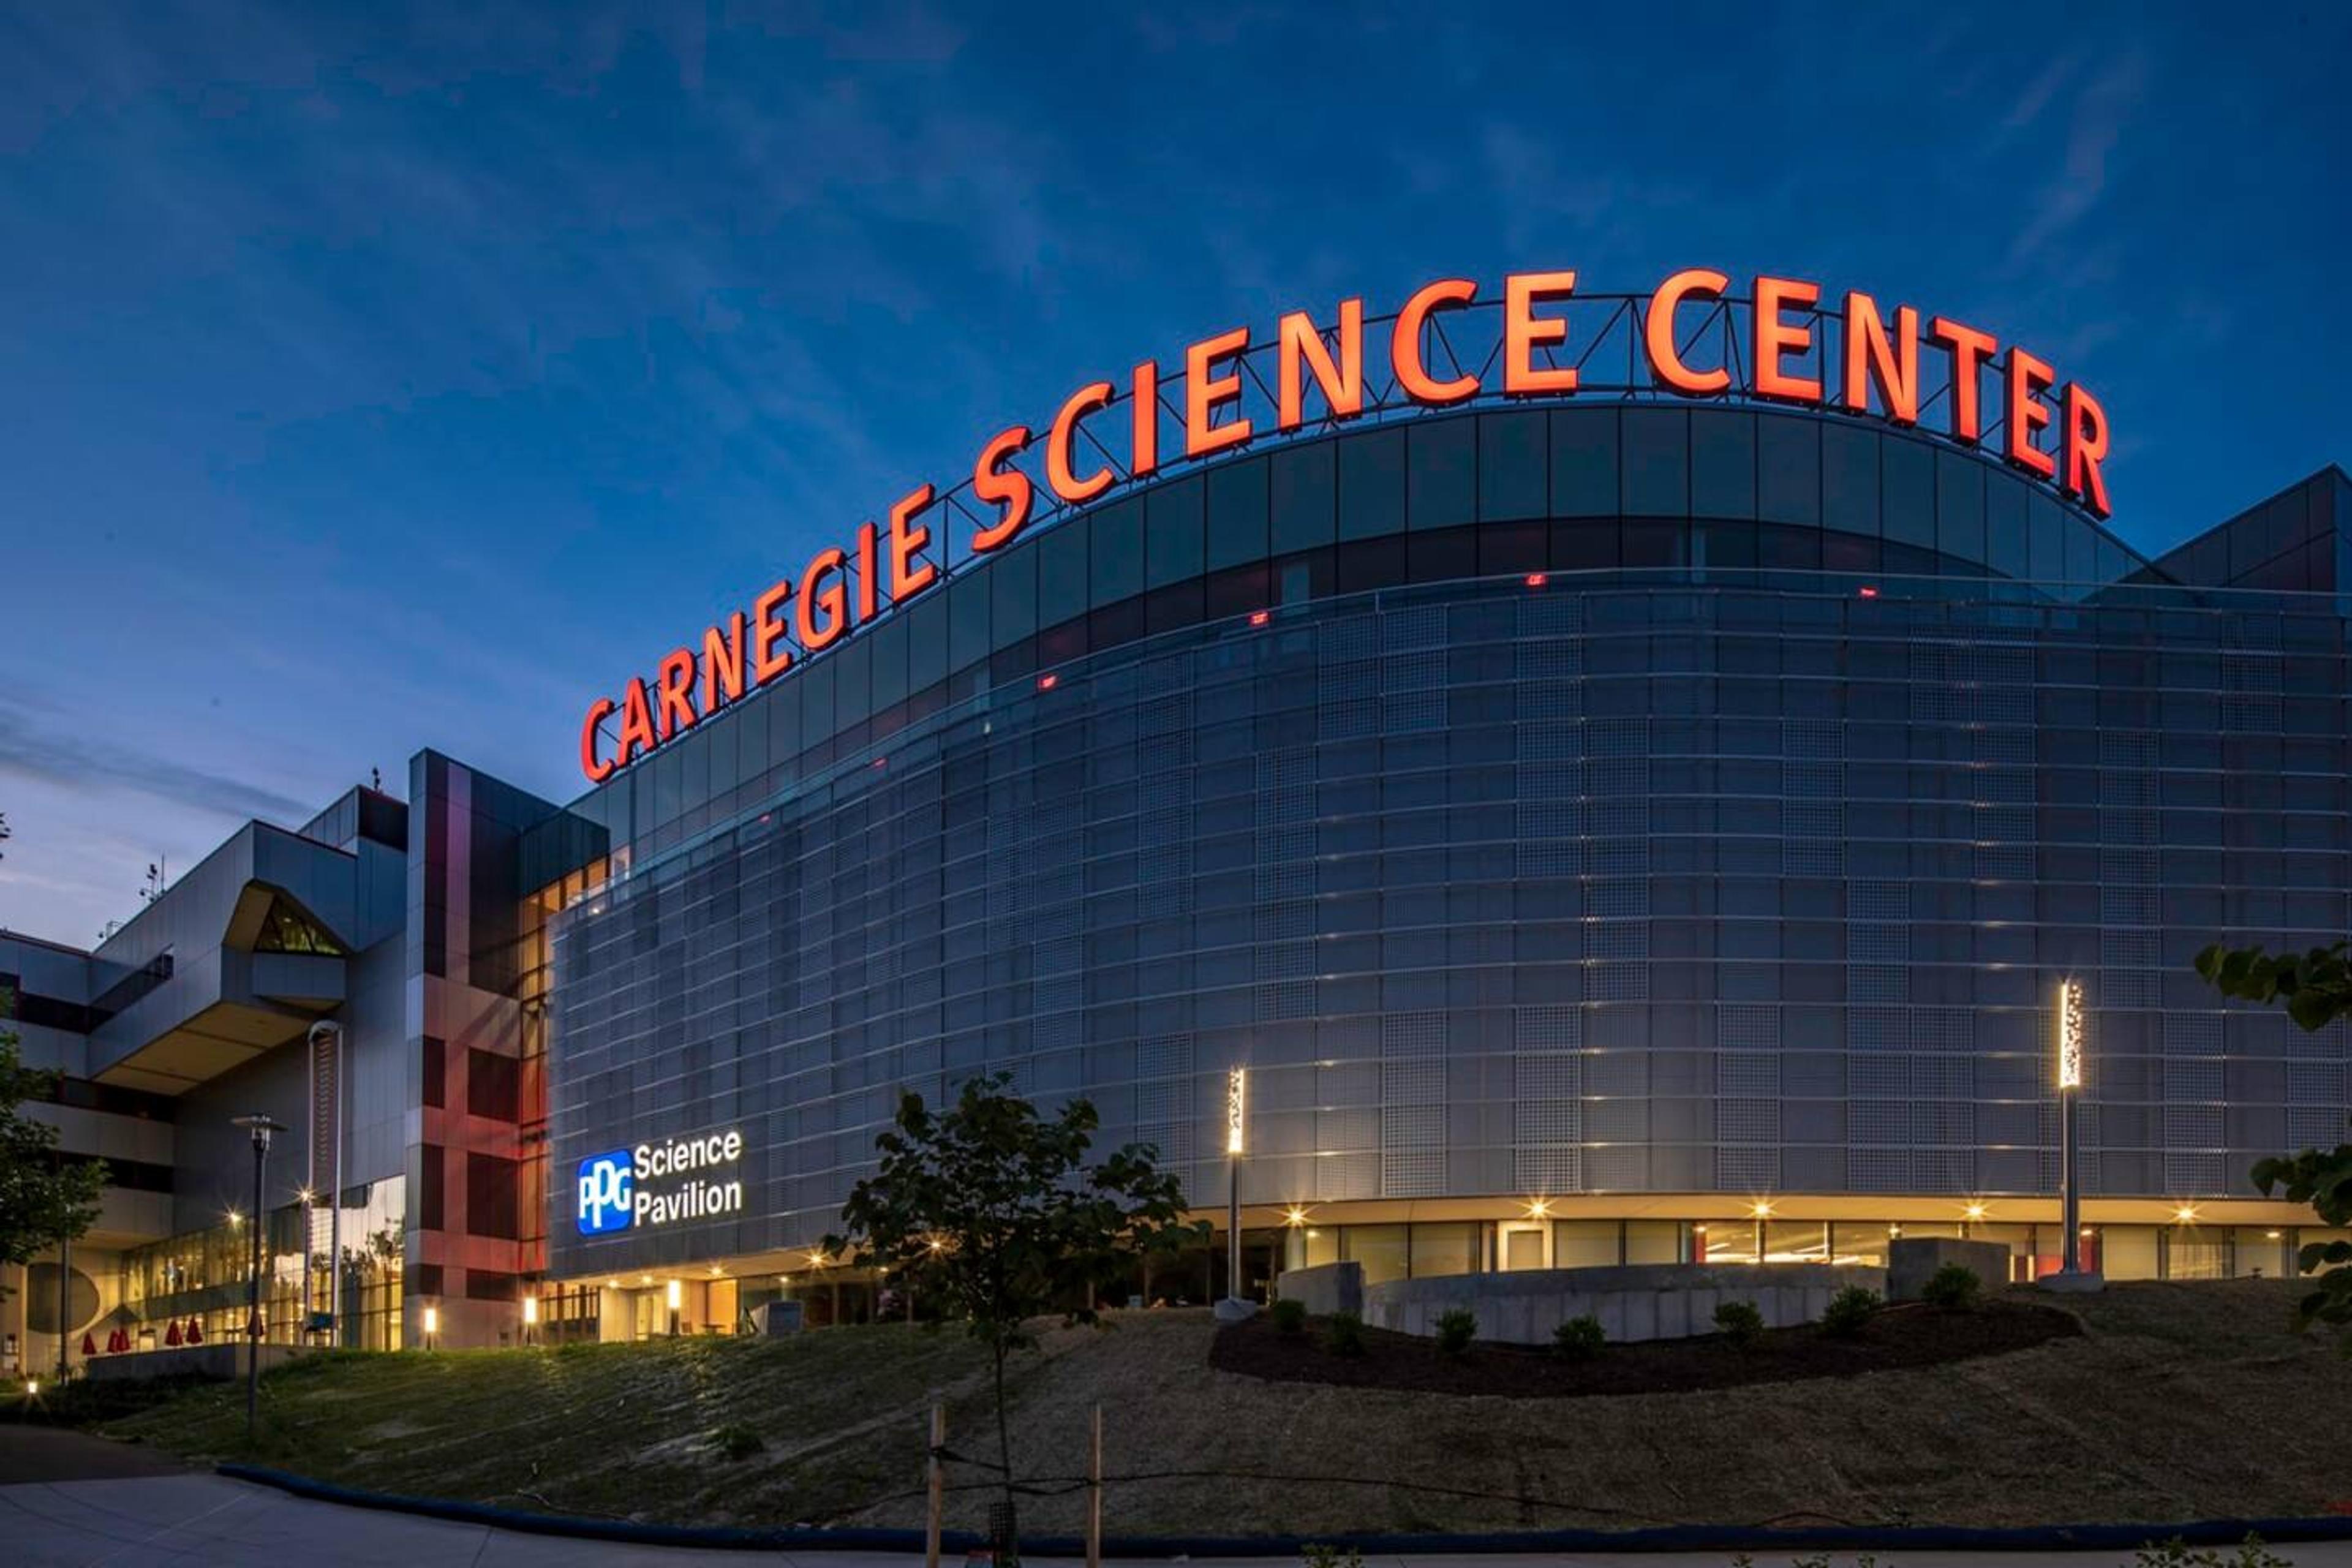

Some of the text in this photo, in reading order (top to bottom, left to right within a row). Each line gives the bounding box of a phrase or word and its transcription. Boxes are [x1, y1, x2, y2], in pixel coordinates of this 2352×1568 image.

[581, 268, 2112, 783] CARNEGIE SCIENCE CENTER
[634, 1131, 742, 1179] Science
[579, 1160, 631, 1228] PPG
[634, 1181, 742, 1227] Pavilion
